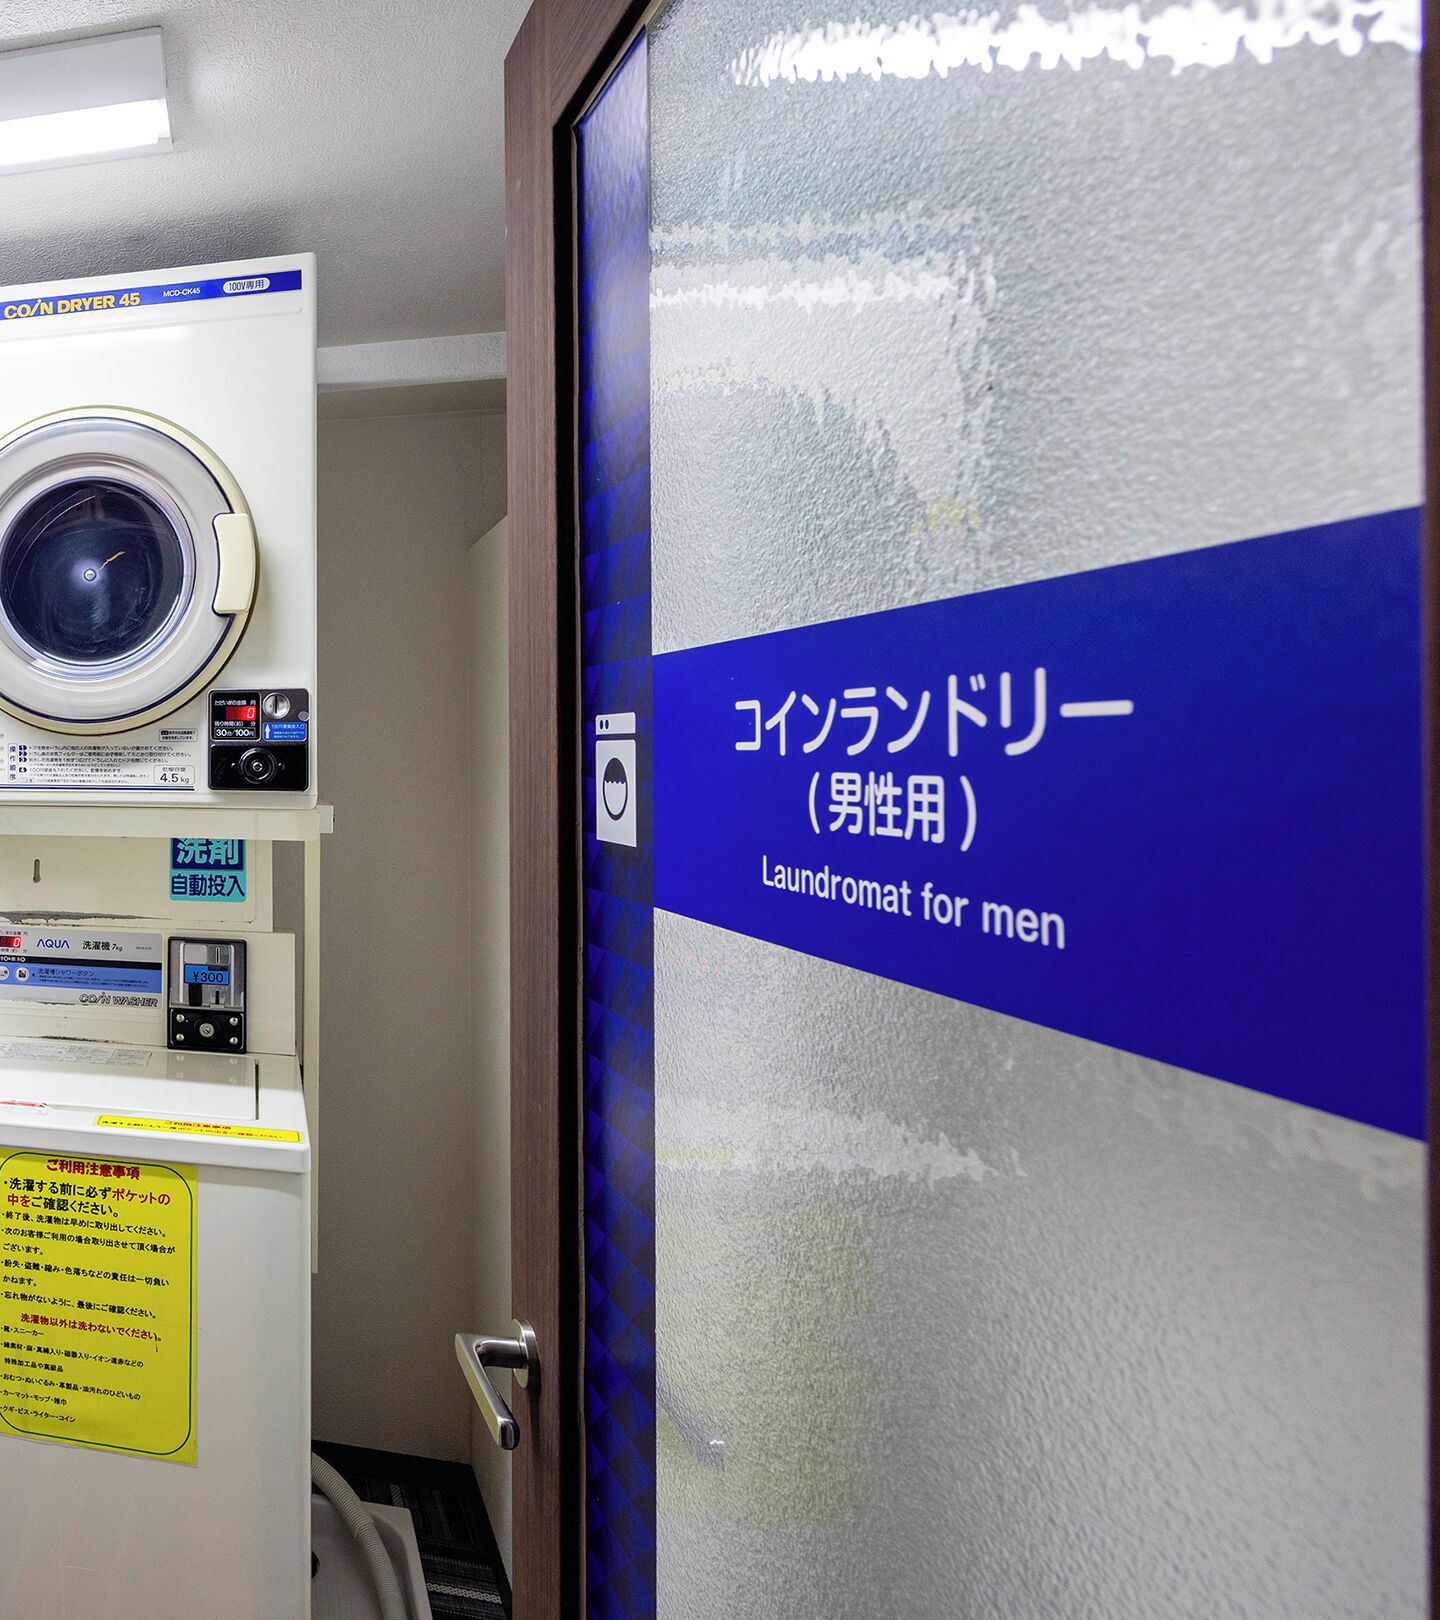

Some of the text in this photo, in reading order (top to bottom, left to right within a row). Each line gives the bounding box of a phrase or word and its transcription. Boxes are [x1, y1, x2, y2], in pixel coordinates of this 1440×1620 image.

[57, 296, 115, 316] DRYER
[118, 292, 140, 307] 45
[246, 707, 255, 719] 0
[734, 666, 1135, 758] コインランドリー
[160, 773, 190, 784] 4.5 kg
[176, 838, 239, 865] 洗剤
[171, 873, 246, 897] 自動投入
[761, 854, 1065, 950] Laundromat for men
[14, 938, 20, 947] 0
[36, 938, 70, 949] AQUA
[82, 940, 110, 951] 洗濯機
[193, 972, 224, 983] ¥300
[114, 996, 158, 1008] WASHER
[46, 1158, 141, 1181] ご利用注意事項
[8, 1193, 119, 1218] 中をご確認ください。
[2, 1242, 44, 1255] ございます。
[2, 1275, 38, 1287] かねます。
[20, 1313, 162, 1342] 洗濯物以外は洗わないでください。
